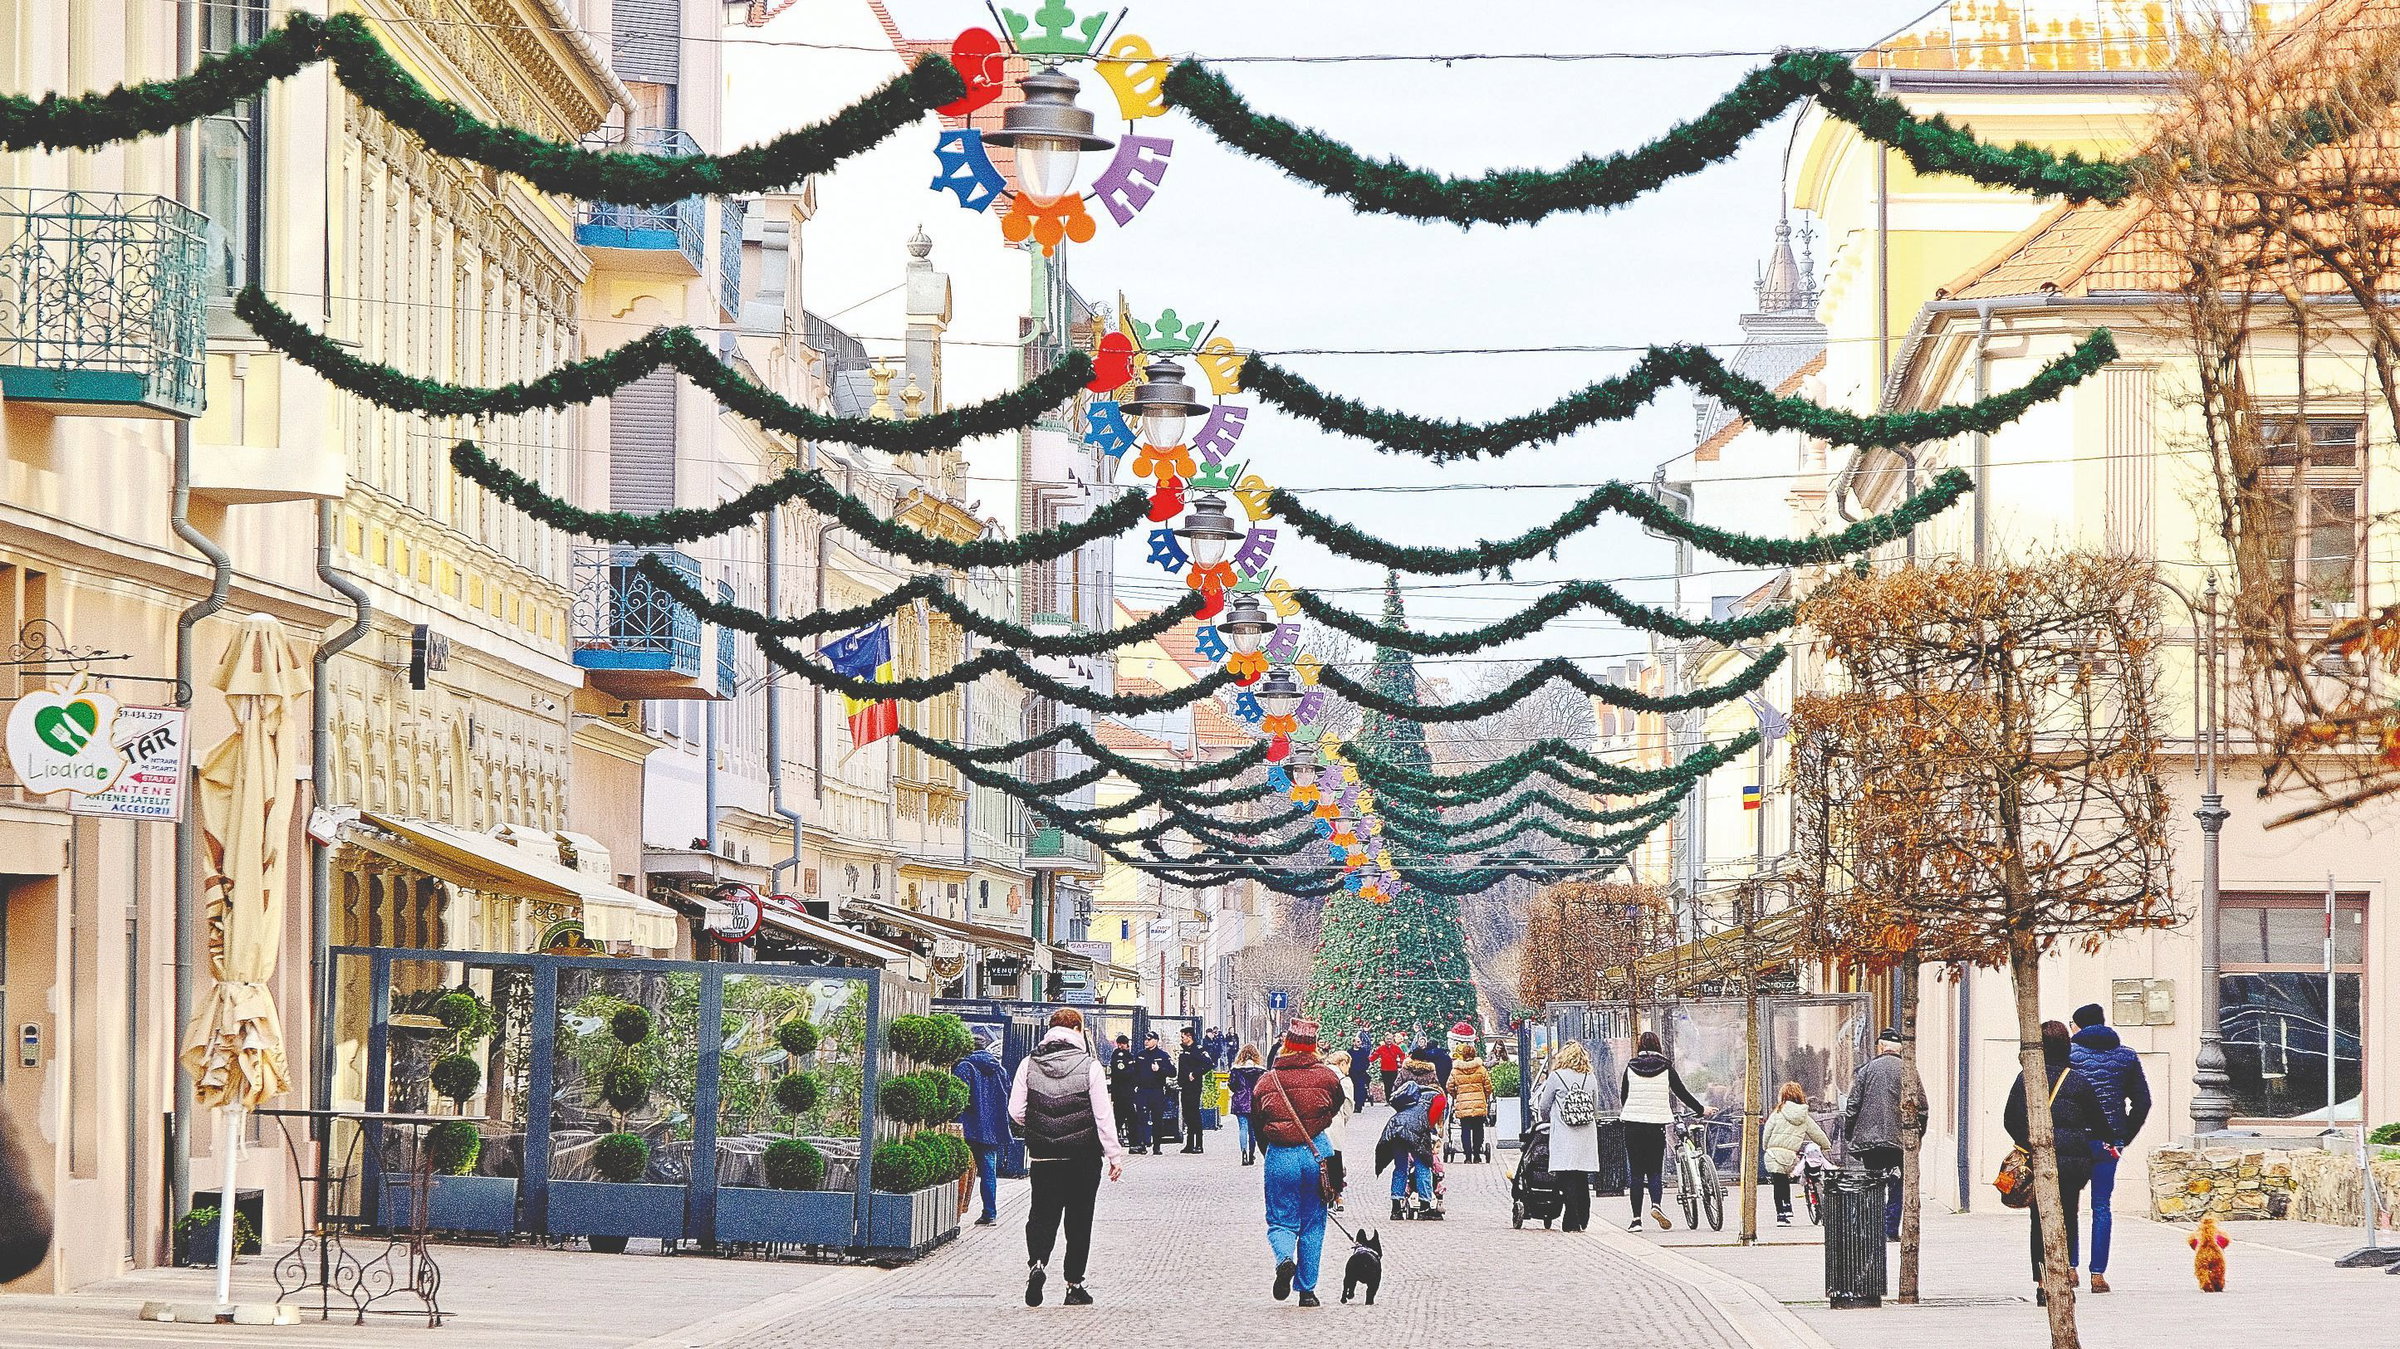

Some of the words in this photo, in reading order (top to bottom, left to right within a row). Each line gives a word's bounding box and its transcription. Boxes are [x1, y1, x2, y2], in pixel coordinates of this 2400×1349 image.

[130, 795, 171, 806] SATELIT
[111, 803, 170, 815] ACCESORII
[991, 966, 1018, 977] VENUE
